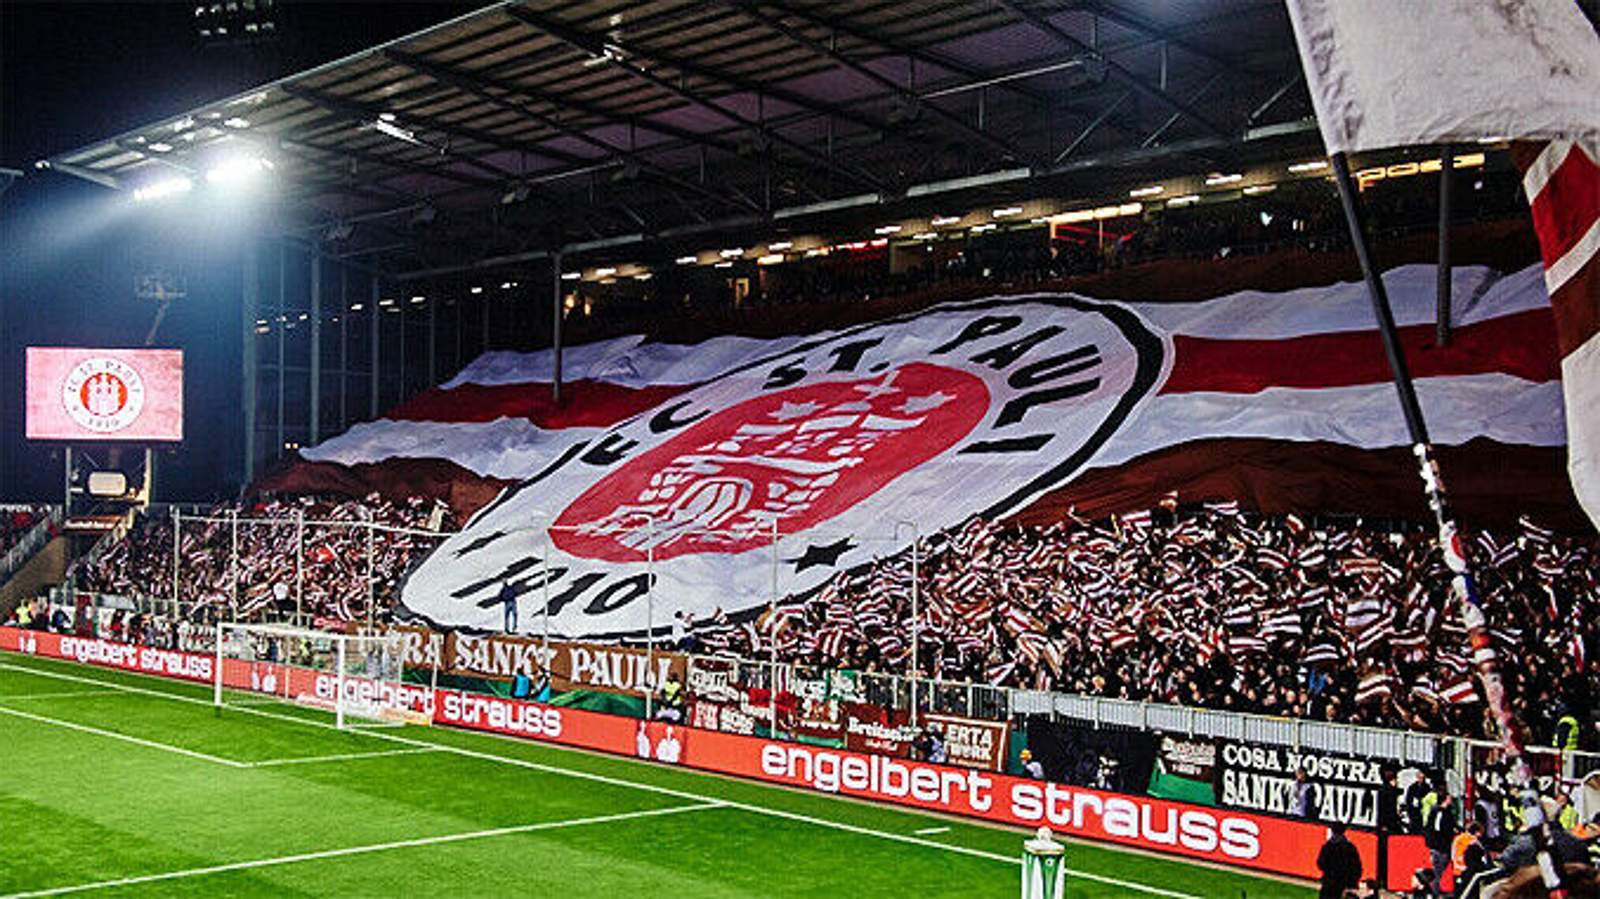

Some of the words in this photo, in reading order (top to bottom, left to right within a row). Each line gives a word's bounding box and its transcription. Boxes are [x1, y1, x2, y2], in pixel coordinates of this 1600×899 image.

[929, 315, 1103, 454] PAULI
[450, 556, 657, 616] 1910
[60, 637, 138, 669] engelbert
[140, 648, 212, 679] strauss
[568, 647, 672, 693] PAULI
[315, 673, 436, 716] engelbert
[443, 691, 562, 738] strauss
[1222, 743, 1282, 772] COSA
[1285, 748, 1384, 785] NOSTRA
[761, 743, 993, 812] engelbert
[1010, 782, 1261, 859] strauss
